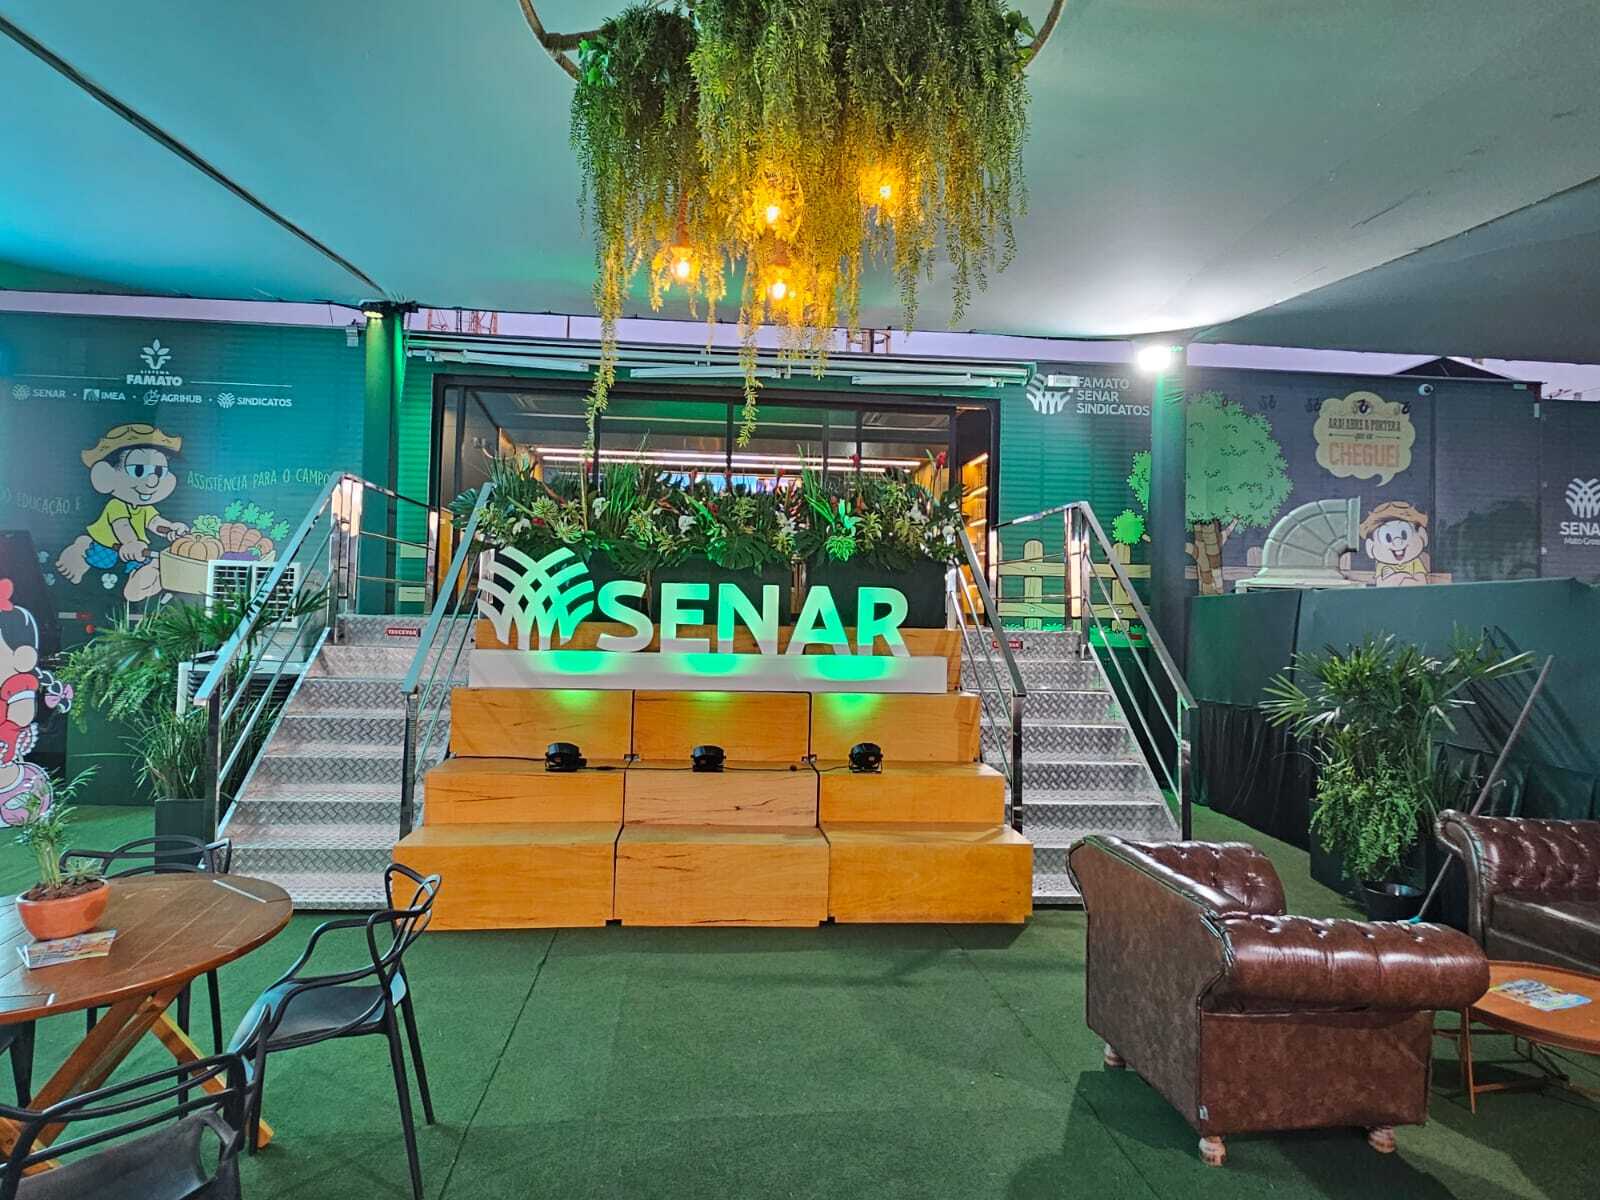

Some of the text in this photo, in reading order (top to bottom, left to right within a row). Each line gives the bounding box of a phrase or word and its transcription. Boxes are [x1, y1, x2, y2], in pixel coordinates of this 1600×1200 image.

[126, 374, 183, 387] FAMATO
[1078, 377, 1129, 388] FAMATO
[32, 388, 67, 399] SENAR
[101, 391, 126, 401] IMEA
[160, 393, 202, 404] AGRIHUB
[1076, 391, 1119, 402] SENAR
[236, 397, 293, 407] SINDICATOS
[1076, 403, 1150, 416] SINDICATOS
[252, 470, 277, 489] PARA
[282, 468, 291, 484] O
[295, 468, 329, 489] CAMPO
[1560, 521, 1600, 536] SENA
[596, 581, 910, 657] SENAR
